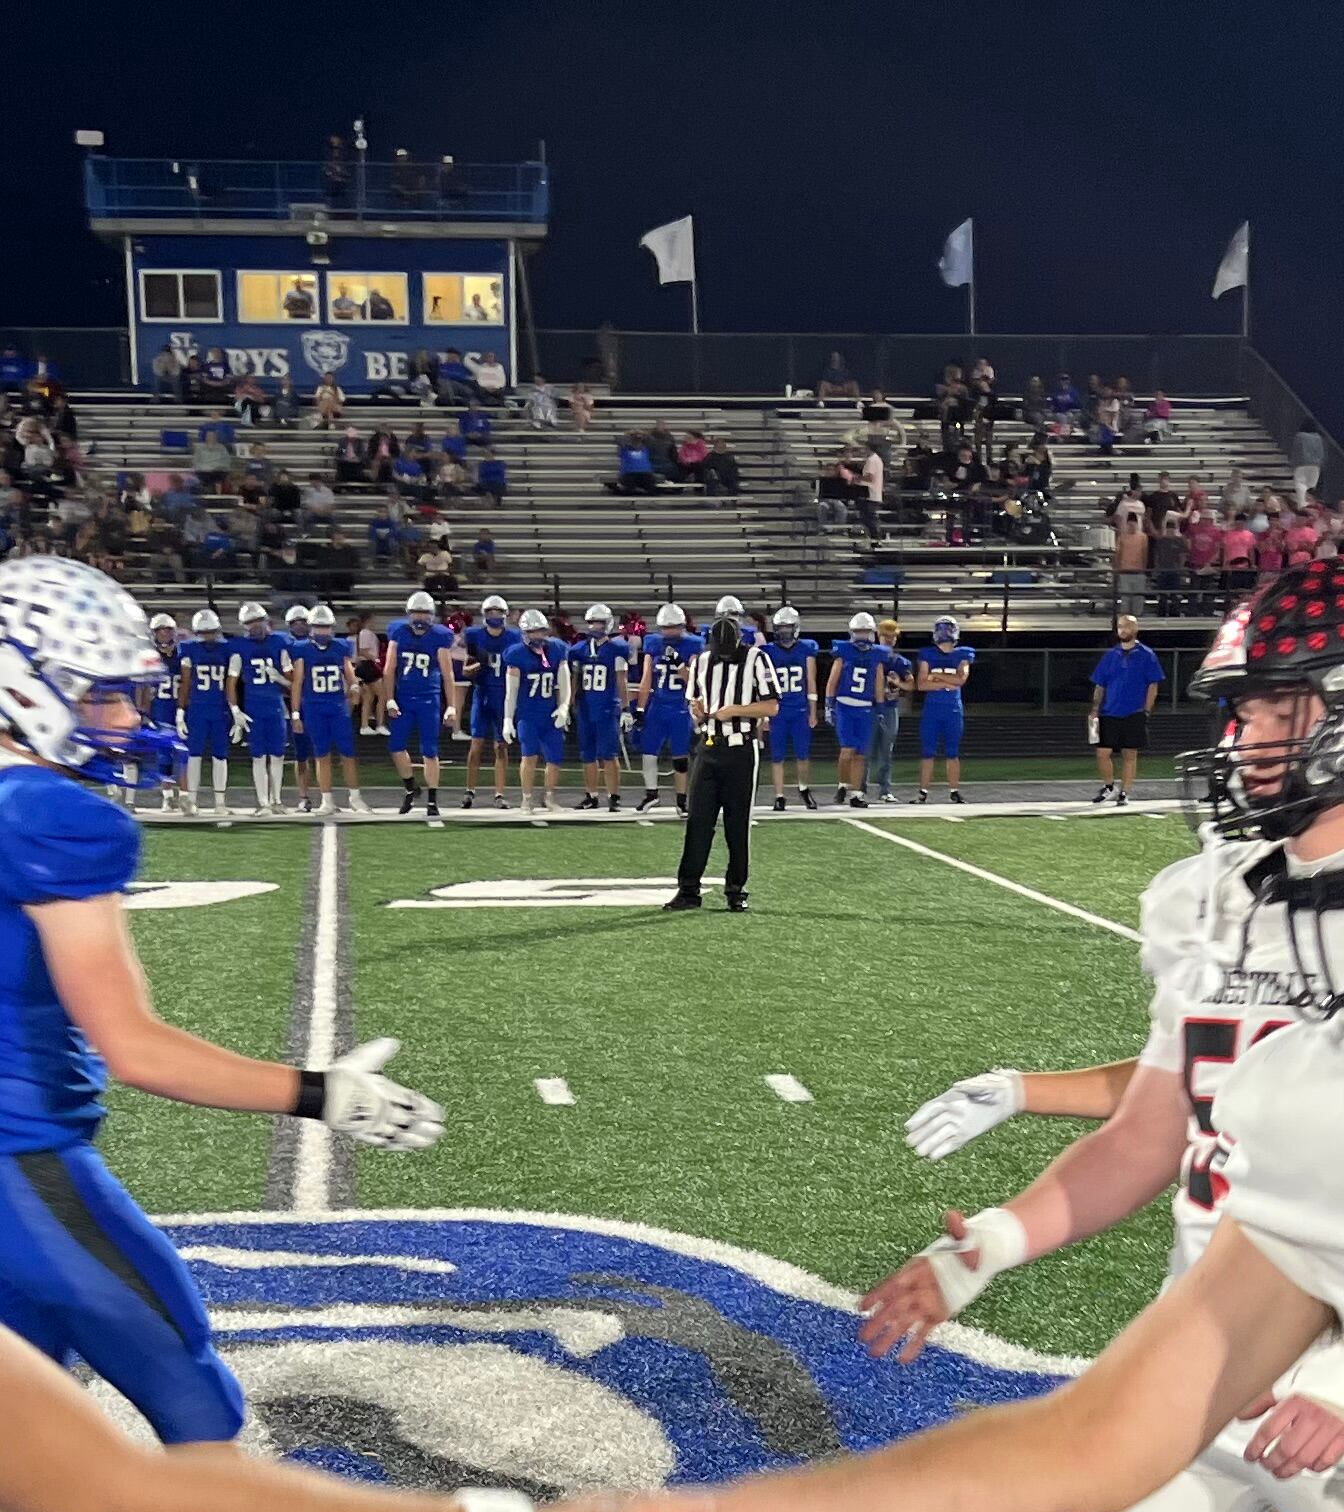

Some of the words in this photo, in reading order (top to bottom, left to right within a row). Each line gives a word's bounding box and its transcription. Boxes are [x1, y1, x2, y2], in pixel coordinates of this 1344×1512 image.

[402, 652, 430, 677] 79
[655, 664, 683, 690] 72
[197, 665, 225, 691] 54
[312, 665, 341, 692] 62
[527, 673, 553, 699] 70
[776, 666, 803, 692] 32
[851, 667, 867, 693] 5
[1182, 1016, 1296, 1211] 5
